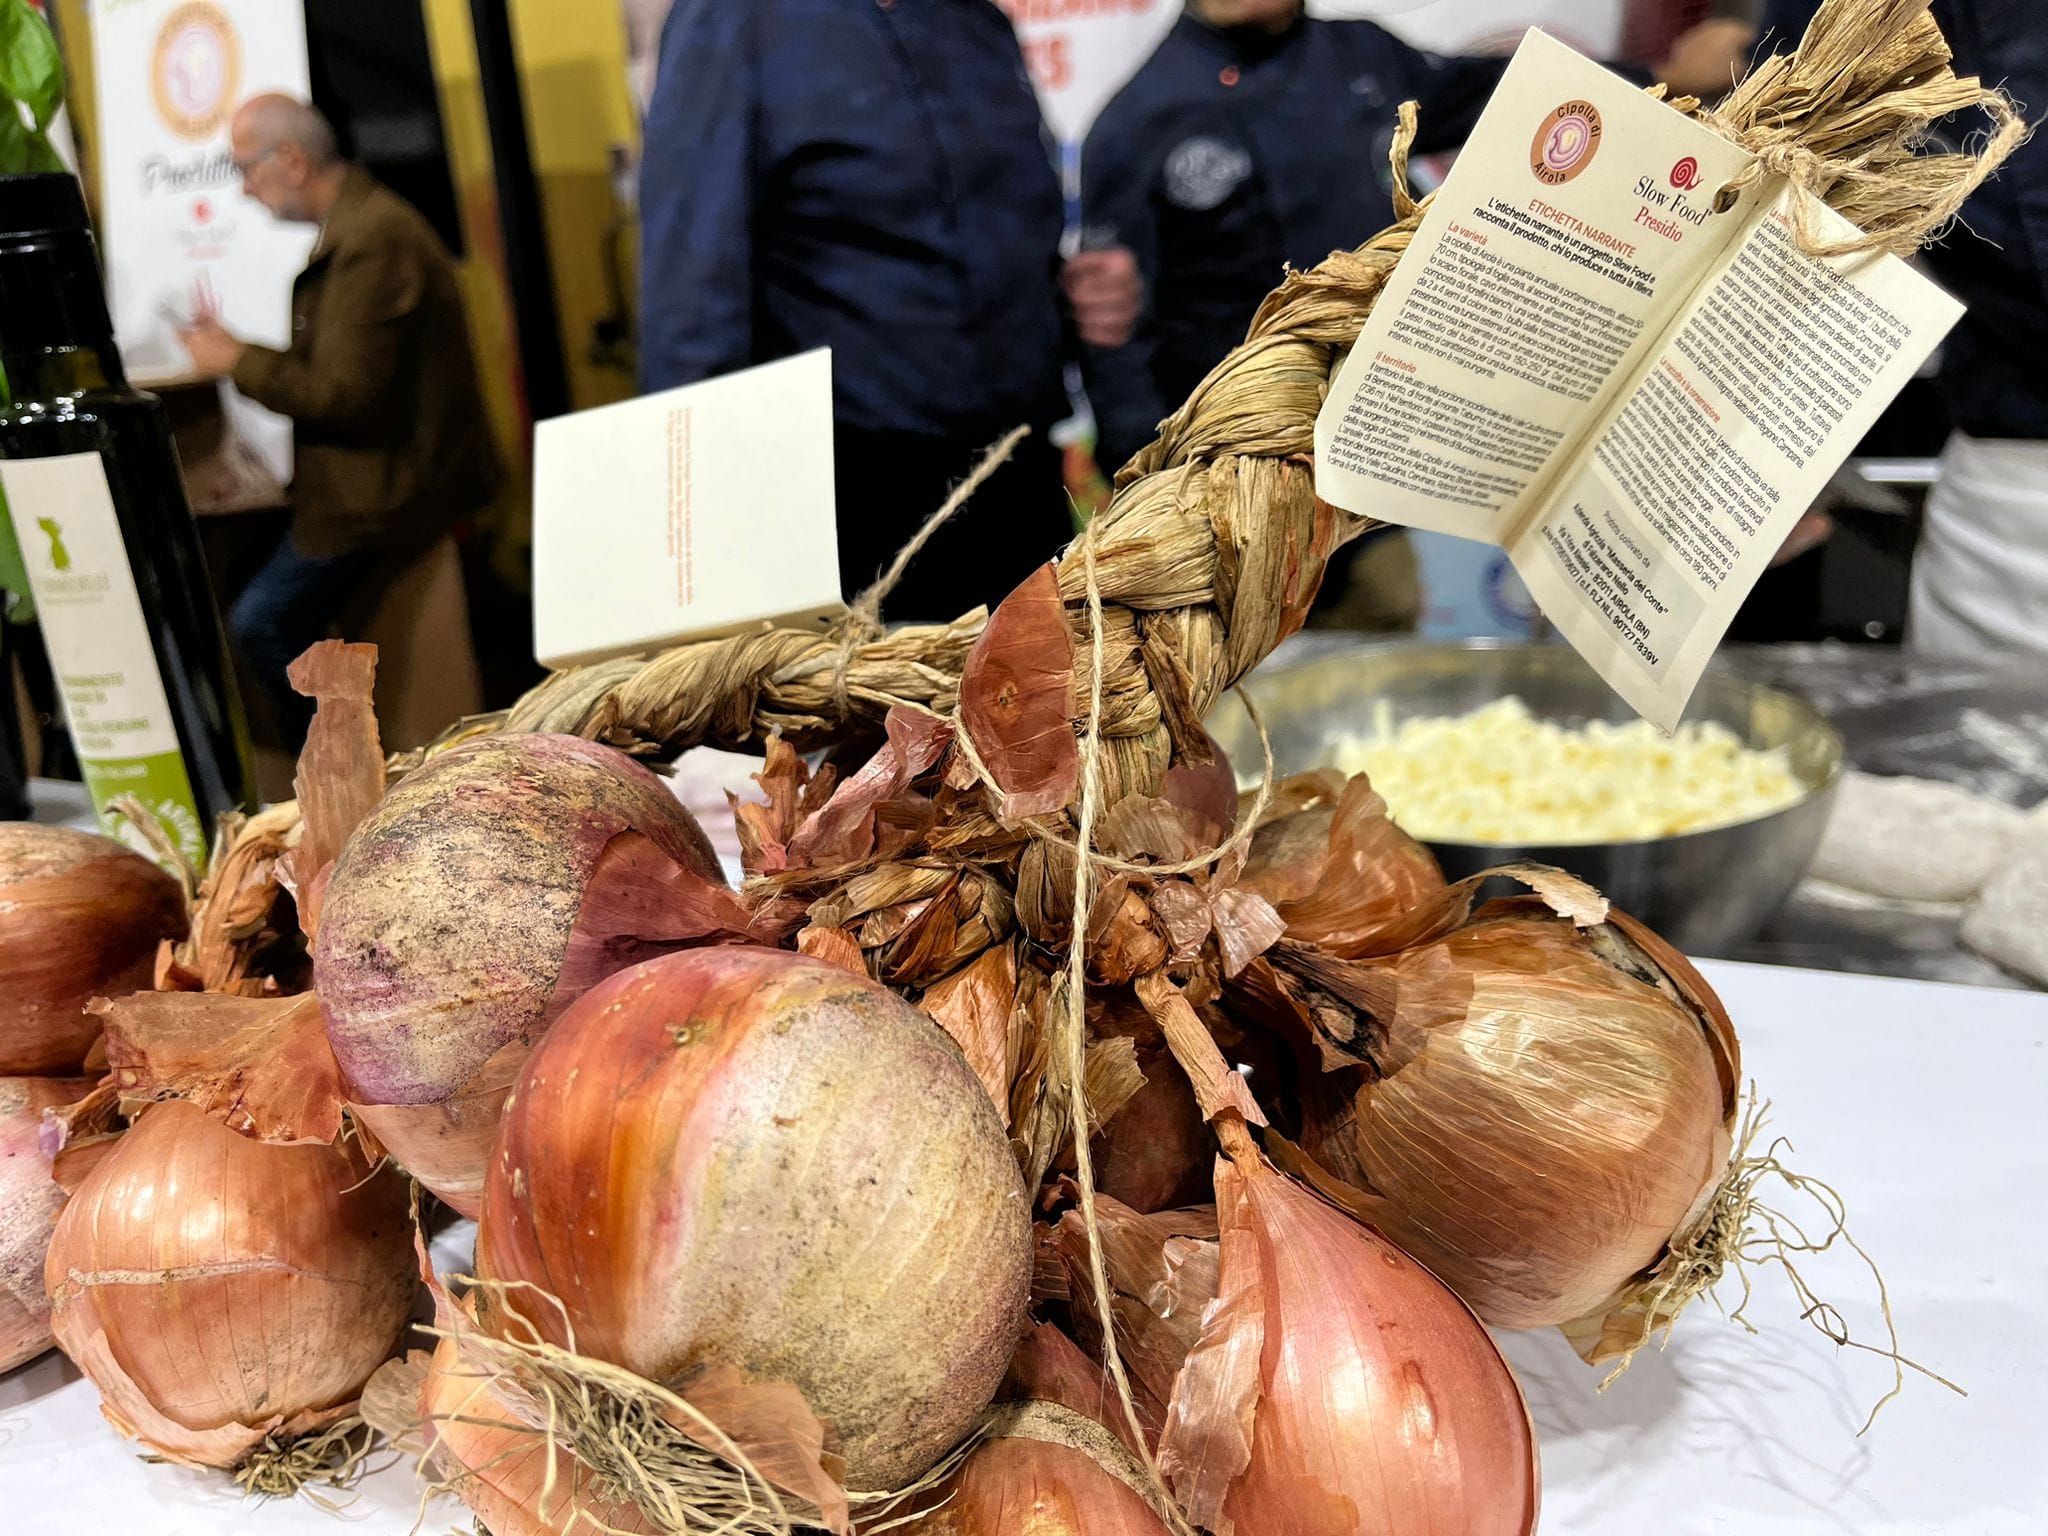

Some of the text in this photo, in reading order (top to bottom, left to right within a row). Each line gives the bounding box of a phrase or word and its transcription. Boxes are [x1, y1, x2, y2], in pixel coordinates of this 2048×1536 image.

[1557, 102, 1601, 139] Cipolla di
[1533, 161, 1567, 184] Airola
[1633, 175, 1670, 206] Slow
[1447, 220, 1489, 245] La varietà
[1472, 206, 1510, 229] racconta
[1507, 222, 1516, 232] il
[1512, 225, 1552, 251] prodotto,
[1549, 242, 1565, 254] chi
[1562, 248, 1573, 258] lo
[1568, 251, 1604, 275] produce
[1607, 269, 1628, 284] tutta
[1625, 277, 1636, 287] la
[1527, 198, 1637, 258] ETICHETTA NARRANTE
[1529, 217, 1566, 240] narrante
[1562, 233, 1572, 243] è
[1568, 238, 1581, 248] un
[1578, 241, 1615, 265] progetto
[1611, 256, 1633, 272] Slow
[1630, 265, 1652, 280] Food
[1634, 206, 1684, 242] Presidio
[1421, 266, 1456, 287] composta
[1435, 259, 1458, 275] scapo
[1449, 236, 1473, 254] cipolla
[1477, 249, 1498, 263] Airola
[1500, 261, 1515, 271] una
[1512, 265, 1536, 282] pianta
[1533, 274, 1561, 291] annuale
[1456, 253, 1487, 273] tipologia
[1490, 268, 1511, 284] foglia
[1532, 287, 1561, 304] secondo
[1443, 287, 1461, 300] semi
[1466, 297, 1488, 312] colore
[1826, 287, 1848, 309] Cipolla
[1871, 321, 1889, 339] bulbi
[1885, 332, 1903, 350] della
[1841, 279, 1866, 302] coltivato
[1862, 295, 1875, 308] dai
[1869, 302, 1901, 331] produttori
[1897, 323, 1912, 338] che
[1374, 351, 1418, 373] Il territorio
[1403, 312, 1423, 325] peso
[1423, 318, 1447, 332] medio
[1446, 327, 1459, 337] del
[1458, 332, 1480, 346] bulbo
[1493, 347, 1513, 359] circa
[1511, 354, 1543, 372] 150-250
[1412, 339, 1434, 353] inoltre
[1432, 349, 1446, 358] non
[1451, 355, 1465, 365] mai
[1815, 336, 1872, 386] viene concimato con
[1842, 318, 1859, 335] della
[1883, 351, 1893, 362] si
[1664, 361, 1683, 383] raccolta
[1687, 386, 1721, 423] conservazione
[1773, 338, 1853, 410] Tutte le fasi di coltivazione sono
[1754, 418, 1780, 445] Regione
[1755, 400, 1816, 457] prodotti ammessi dal
[1756, 381, 1825, 446] coloro che non seguono le
[1718, 459, 1767, 508] prodotto raccolto
[1702, 479, 1757, 539] fenomeni di ristagno
[1619, 529, 1644, 560] coltivato
[1641, 555, 1651, 568] da
[1678, 545, 1694, 564] circa
[1690, 558, 1704, 575] 180
[1591, 572, 1614, 597] 82011
[1609, 593, 1636, 623] AIROLA
[1632, 618, 1651, 640] (BN)
[1611, 573, 1630, 596] Nello
[1633, 576, 1646, 593] del
[1588, 588, 1605, 607] FLZ
[1600, 601, 1614, 618] NLL
[1611, 614, 1635, 642] 90T27
[1632, 635, 1659, 669] F839V
